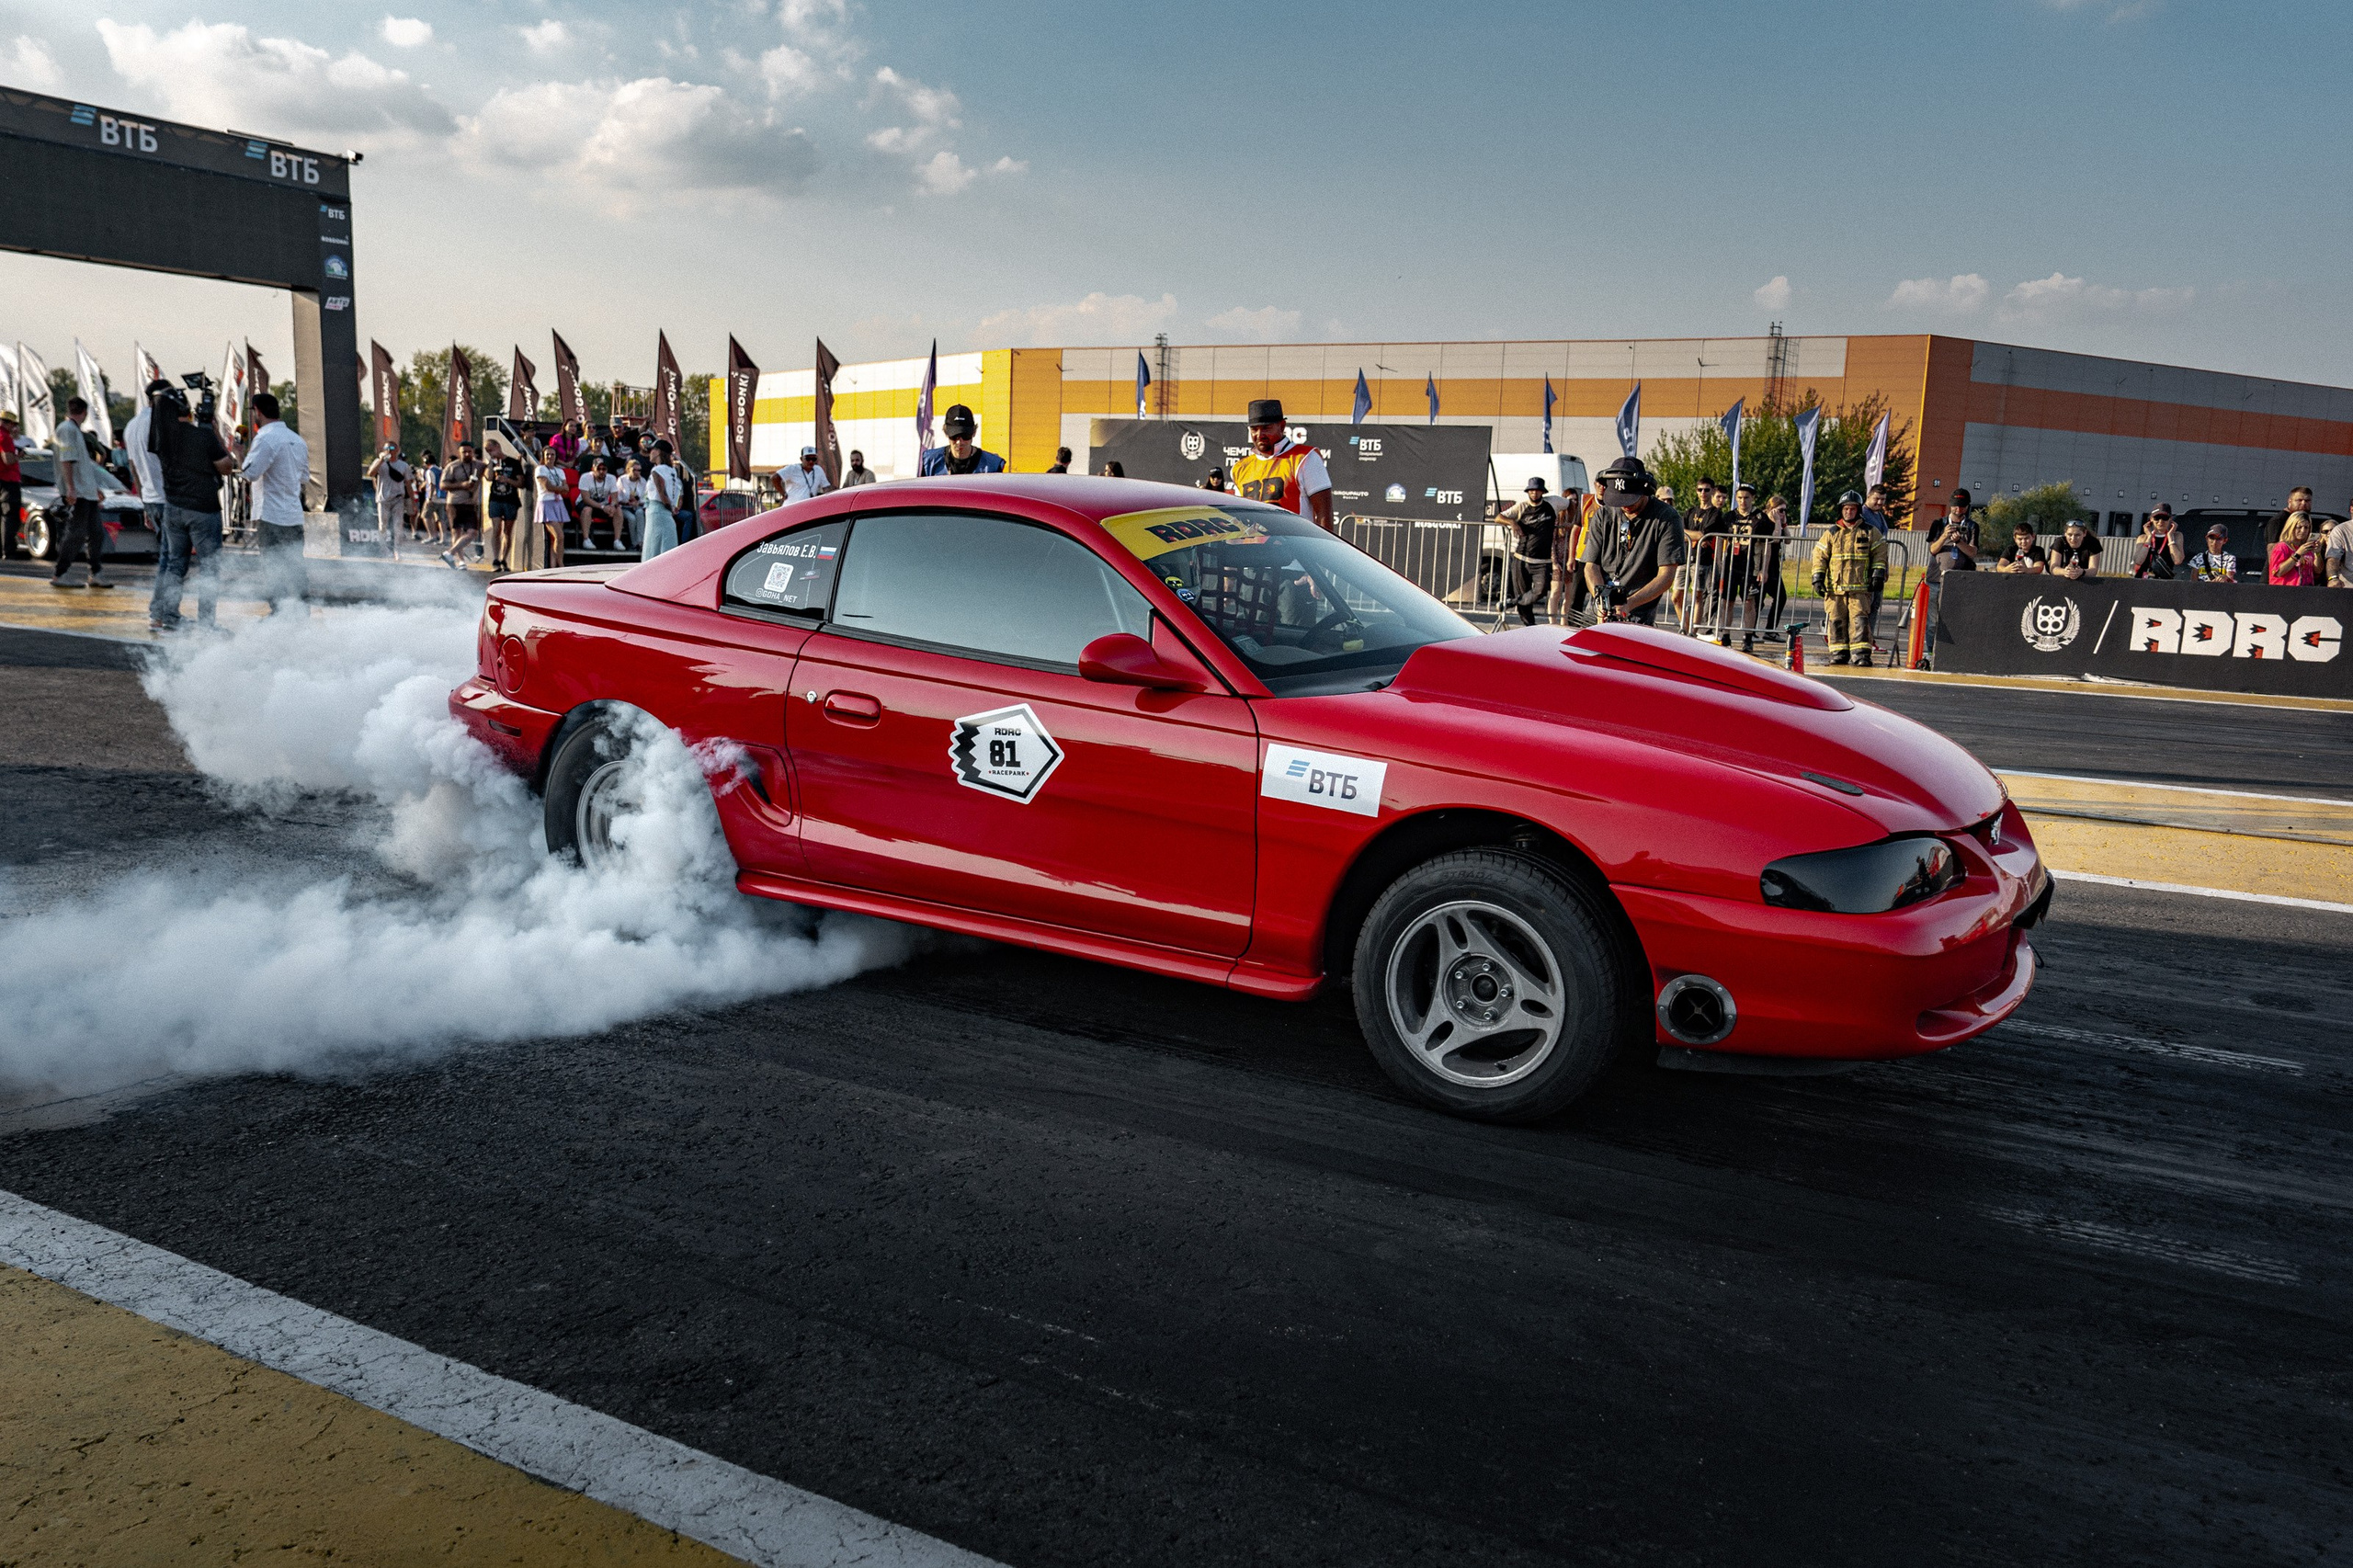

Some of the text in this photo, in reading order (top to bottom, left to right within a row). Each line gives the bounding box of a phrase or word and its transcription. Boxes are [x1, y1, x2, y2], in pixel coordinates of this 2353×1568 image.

[100, 115, 158, 153] ВТБ
[270, 151, 320, 184] ВТБ
[328, 209, 346, 220] ВТБ
[736, 373, 750, 444] ROSGONKI
[1359, 438, 1381, 451] ВТБ
[1437, 490, 1463, 504] ВТБ
[1144, 517, 1241, 543] RDRC
[756, 541, 817, 559] Завьялов Е.В.
[2130, 607, 2343, 662] RDRC
[995, 727, 1021, 736] RDRC
[989, 740, 1021, 767] 81
[1309, 769, 1358, 800] ВТБ
